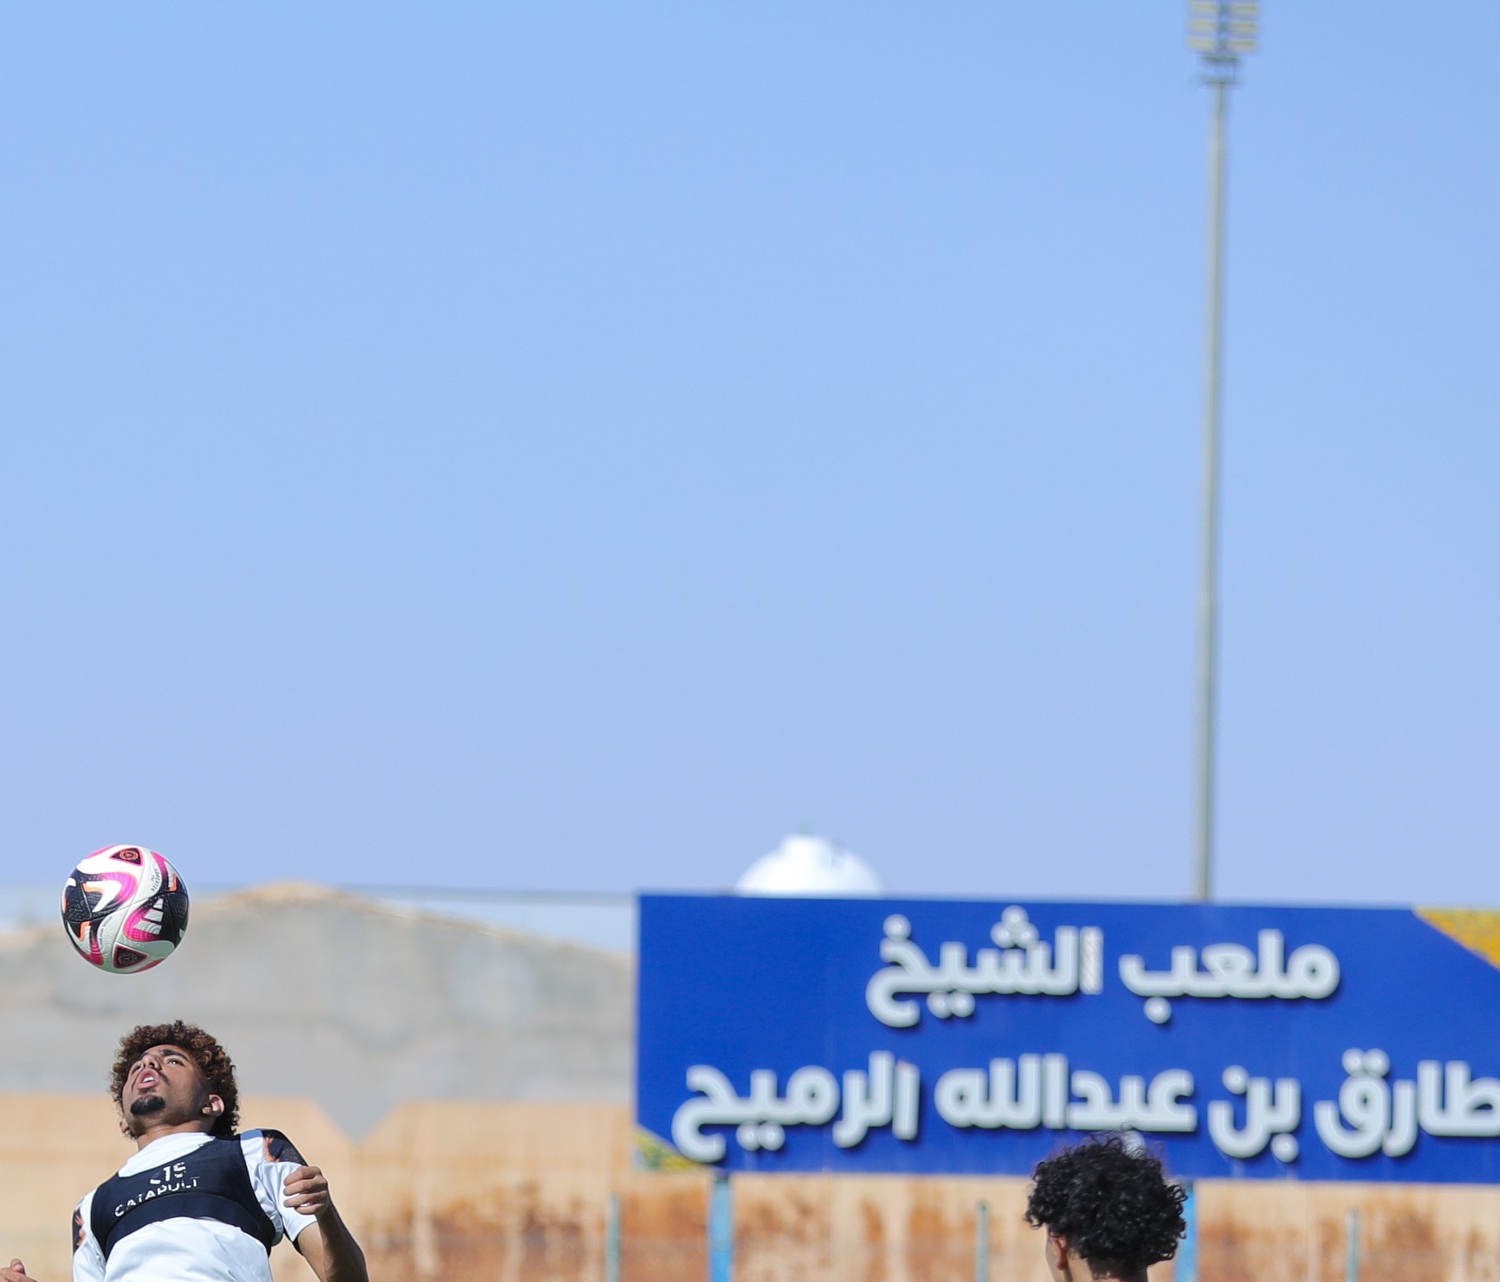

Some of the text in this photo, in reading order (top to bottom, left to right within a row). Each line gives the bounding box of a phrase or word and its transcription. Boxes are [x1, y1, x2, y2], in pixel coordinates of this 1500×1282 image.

[865, 906, 1340, 1028] ملعب الشيخ
[671, 1050, 920, 1163] الرميح
[1206, 1064, 1302, 1162] بن
[1313, 1048, 1500, 1158] طارق
[114, 1176, 201, 1217] CATAPULT
